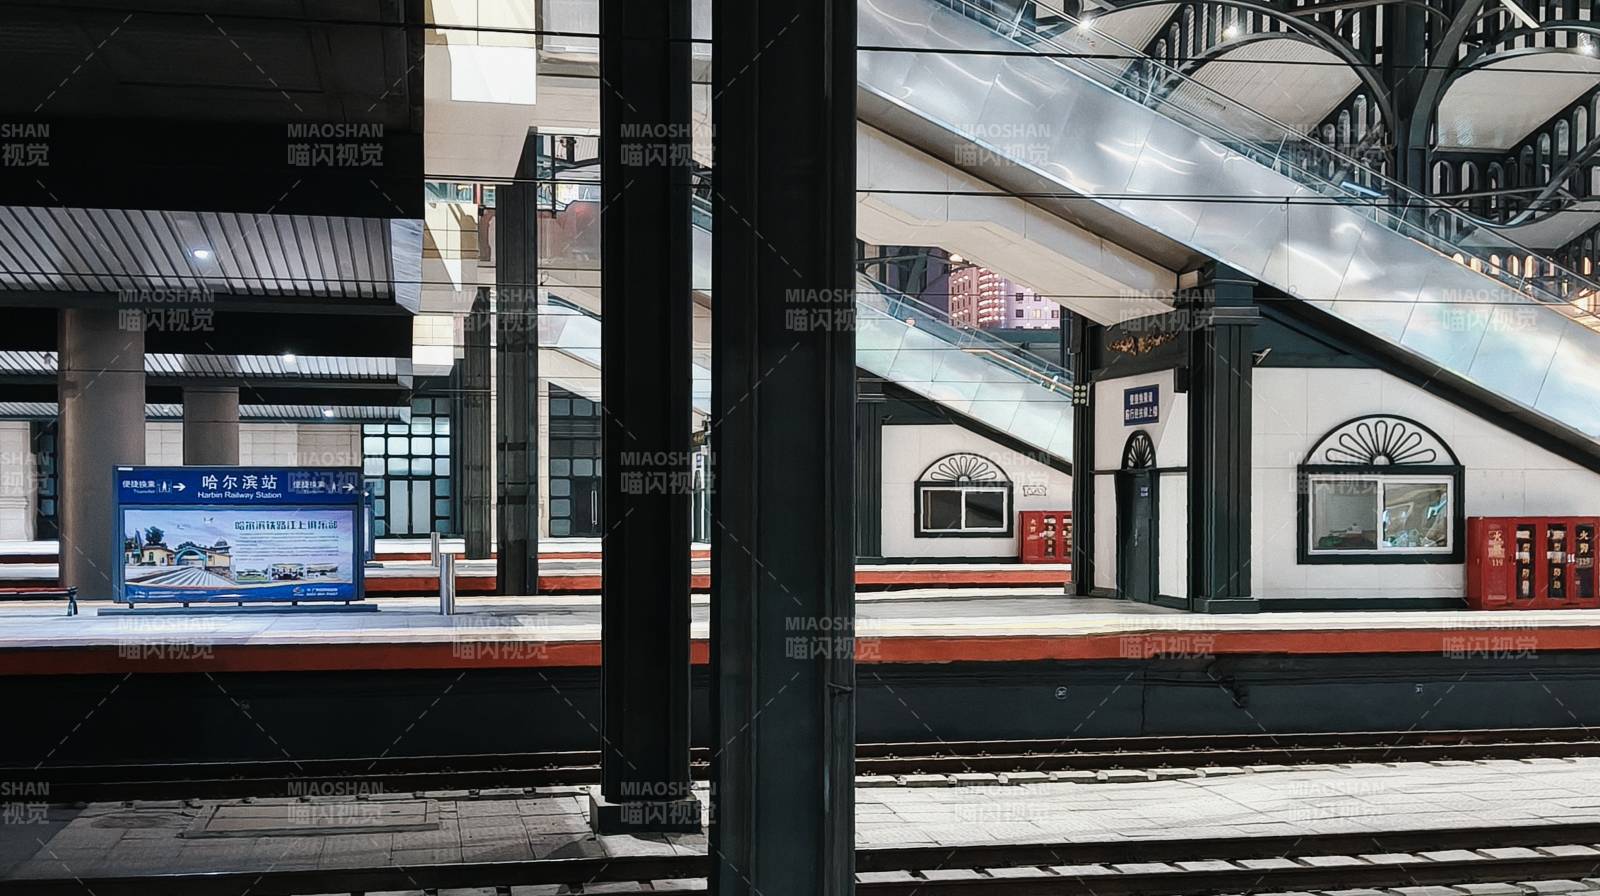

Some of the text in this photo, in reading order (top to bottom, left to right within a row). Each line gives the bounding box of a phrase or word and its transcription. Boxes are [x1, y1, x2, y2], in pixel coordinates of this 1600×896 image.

[202, 474, 278, 490] 哈尔滨站
[224, 492, 254, 500] Railway
